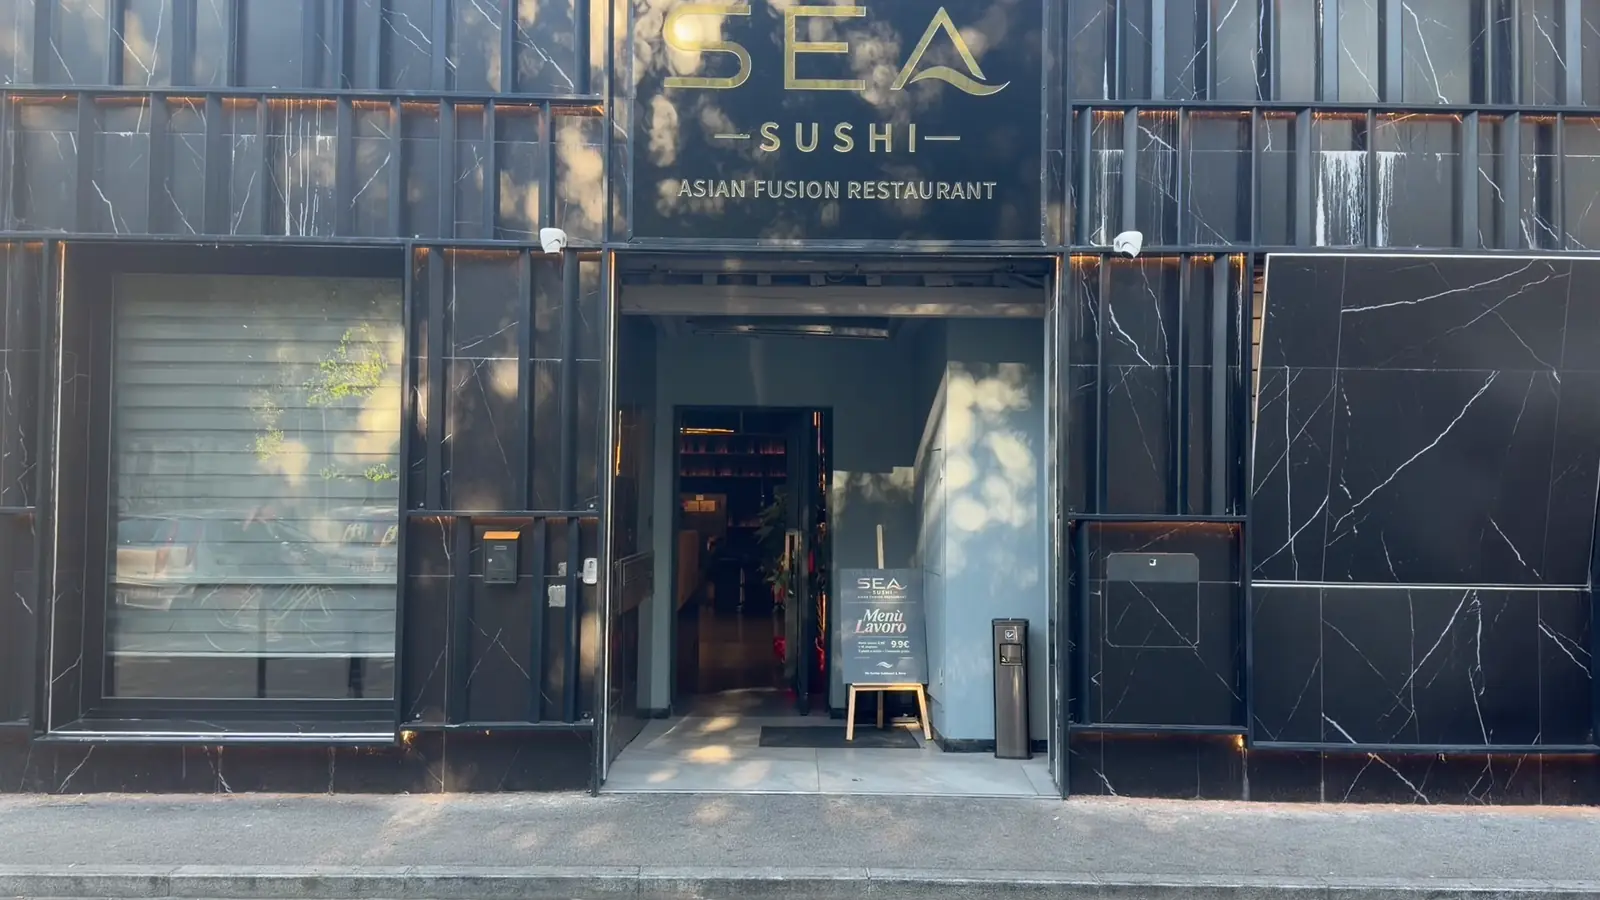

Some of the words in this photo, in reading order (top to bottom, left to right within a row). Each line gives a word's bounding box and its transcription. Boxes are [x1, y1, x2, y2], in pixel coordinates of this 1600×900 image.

[663, 5, 1011, 96] SEA
[759, 121, 917, 153] SUSHI
[678, 179, 746, 199] ASIAN
[754, 179, 840, 200] FUSION
[848, 181, 997, 200] RESTAURANT
[857, 578, 908, 590] SEA
[863, 608, 903, 622] Menù
[853, 620, 907, 634] Lavoro
